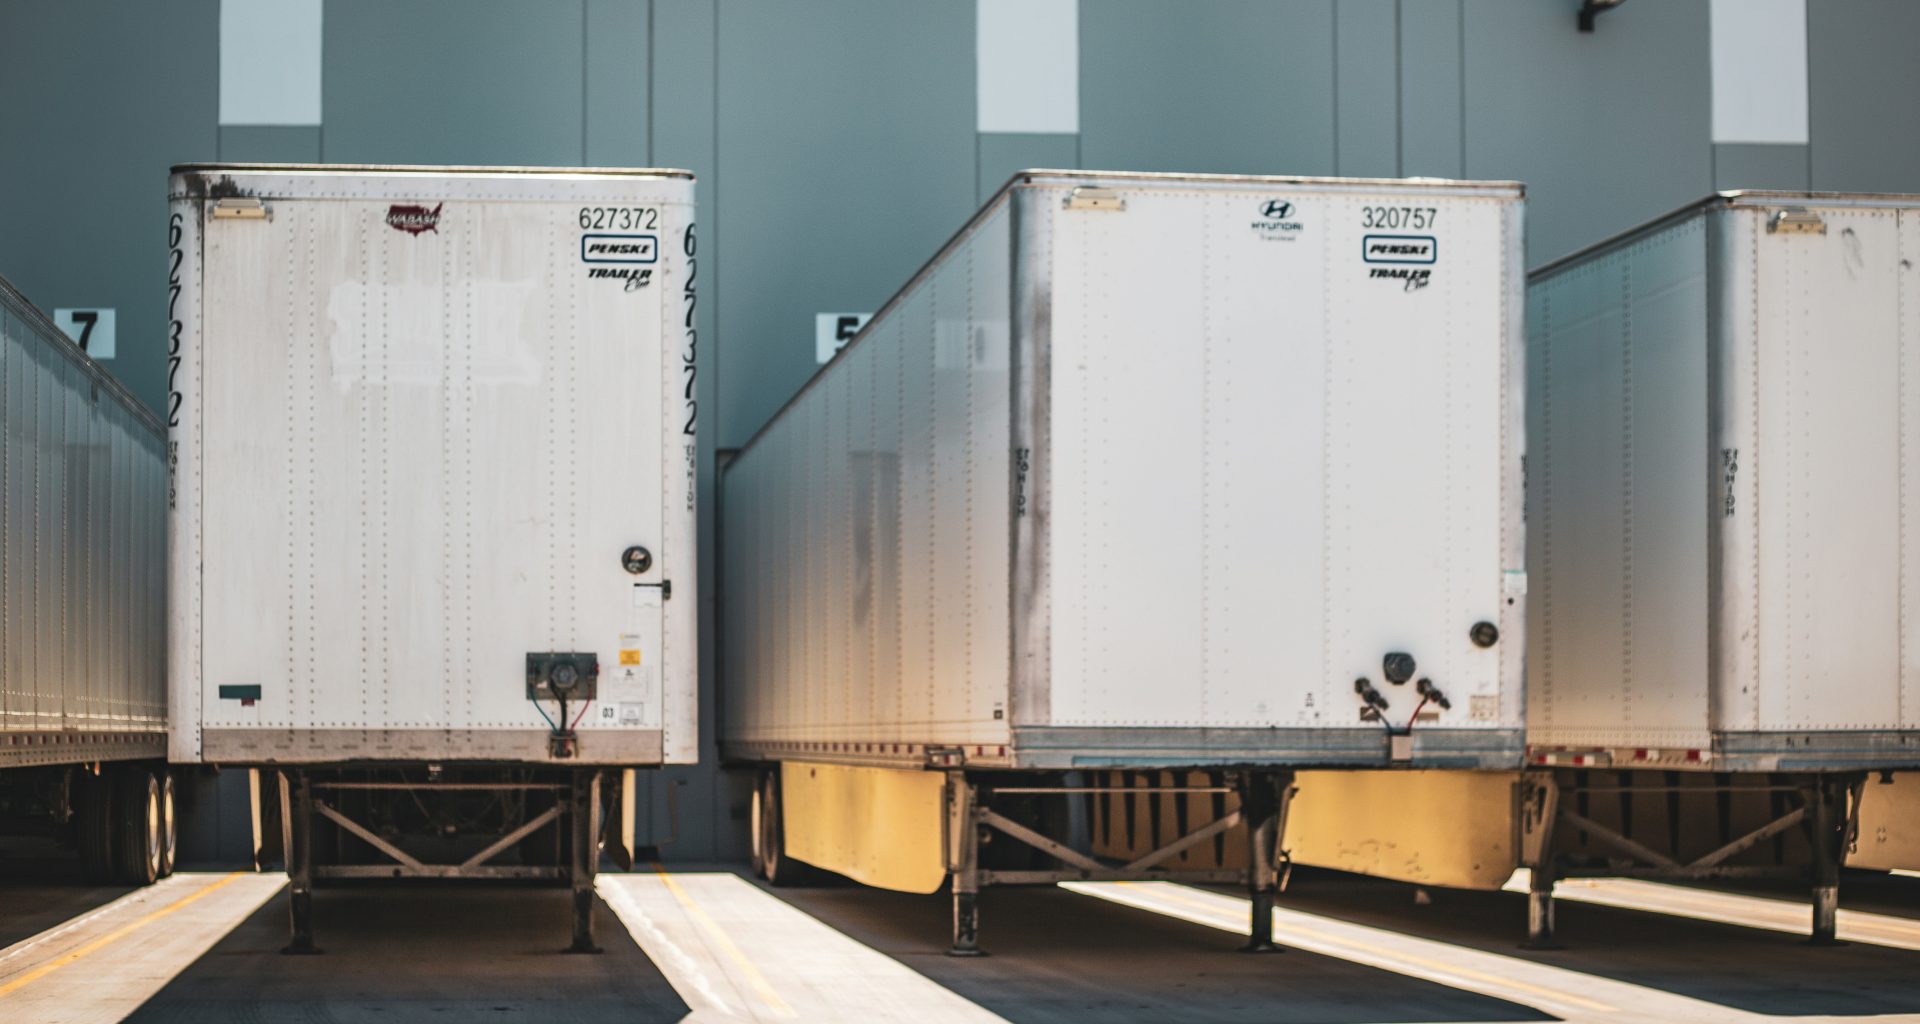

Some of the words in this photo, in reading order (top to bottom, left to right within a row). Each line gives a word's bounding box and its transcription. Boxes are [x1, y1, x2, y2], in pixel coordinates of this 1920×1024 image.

[579, 207, 658, 229] 627372
[1251, 221, 1304, 231] HYUNDAI
[1362, 206, 1438, 229] 320757
[588, 243, 651, 254] PENSKE
[1369, 244, 1429, 255] PENSKE
[588, 267, 653, 282] TRAILER
[1369, 268, 1432, 280] TRAILER
[72, 311, 98, 352] 7
[168, 213, 183, 428] 627372
[683, 222, 698, 435] 627372
[835, 316, 859, 353] 5
